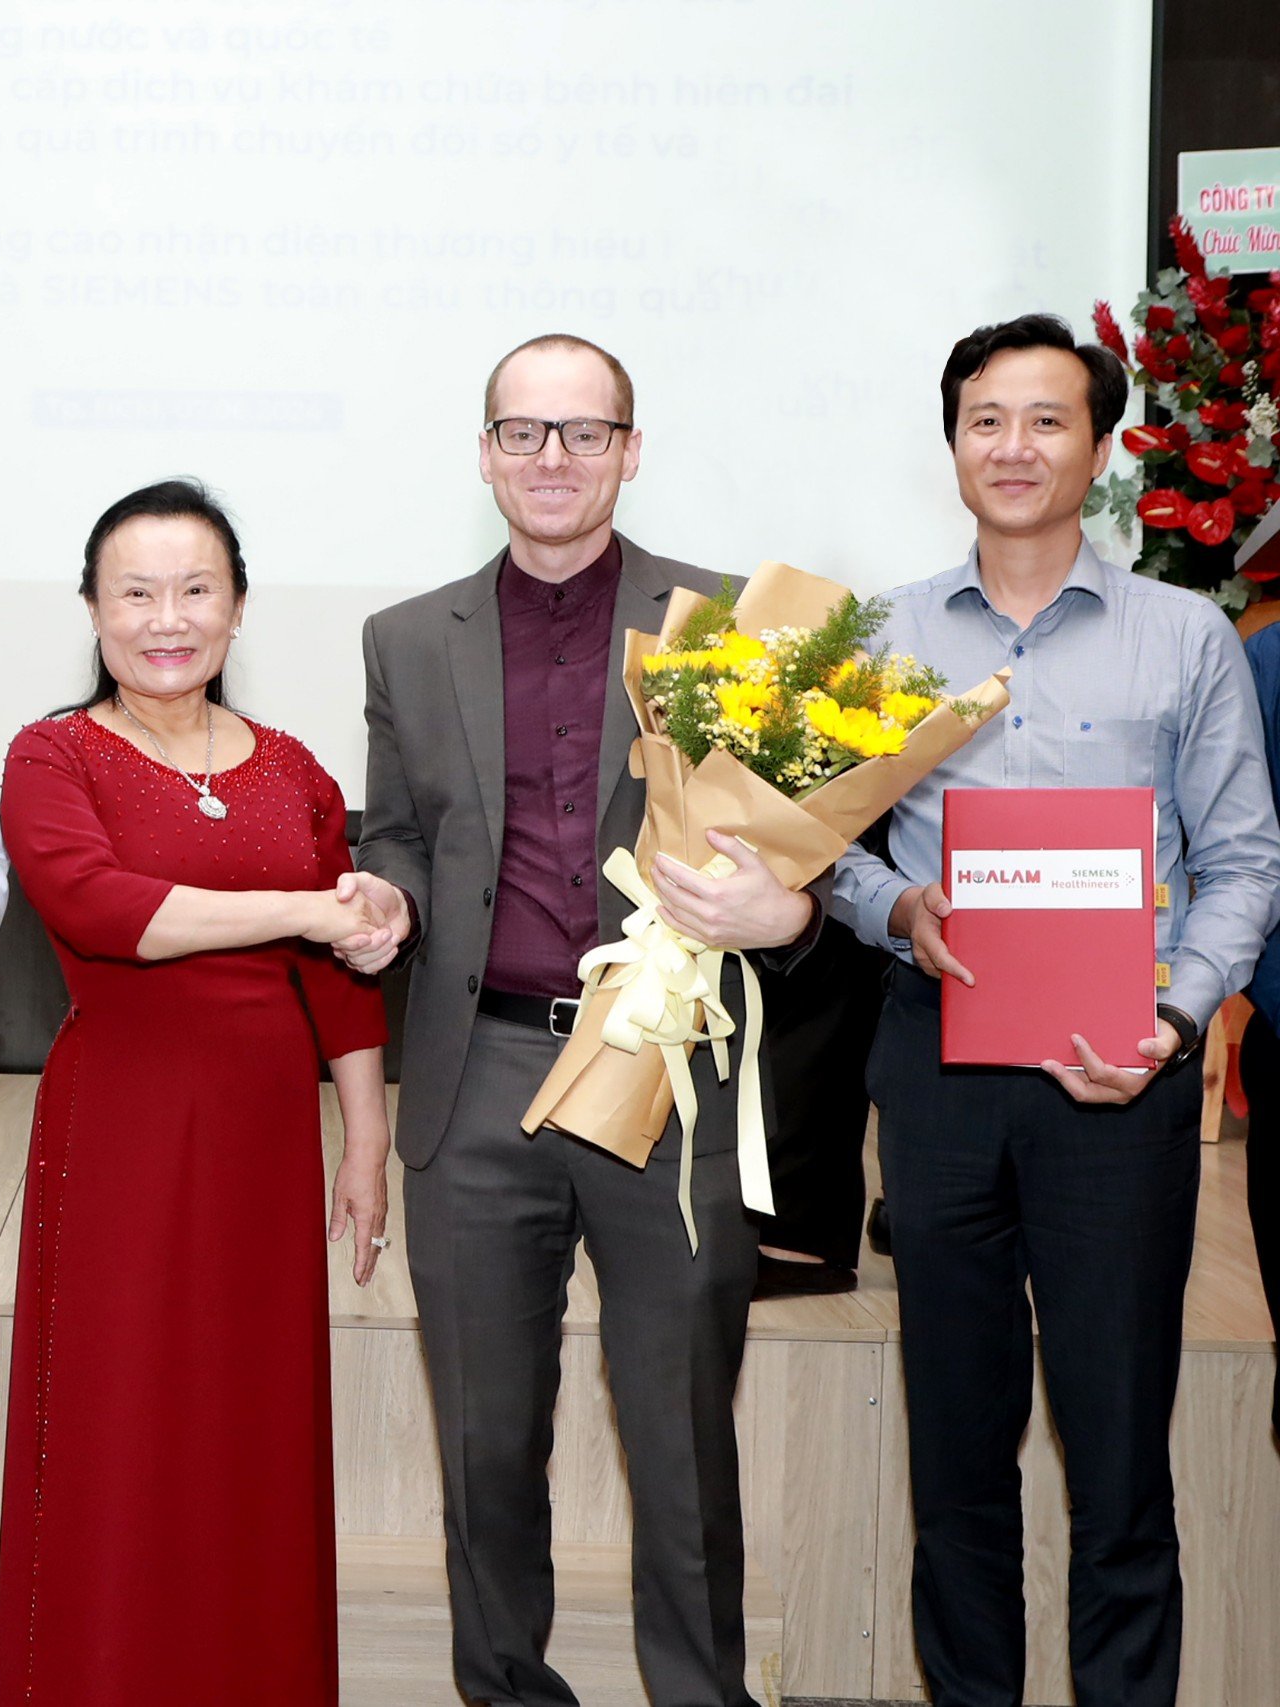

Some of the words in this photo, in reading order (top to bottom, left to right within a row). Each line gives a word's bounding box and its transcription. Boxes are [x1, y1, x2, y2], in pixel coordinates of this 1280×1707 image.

[1200, 183, 1248, 212] CÔNG
[1255, 185, 1276, 208] TY
[1203, 226, 1241, 255] Chúc
[1247, 225, 1280, 252] Mừn
[957, 869, 1042, 884] HOALAM
[1072, 869, 1120, 877] SIEMENS
